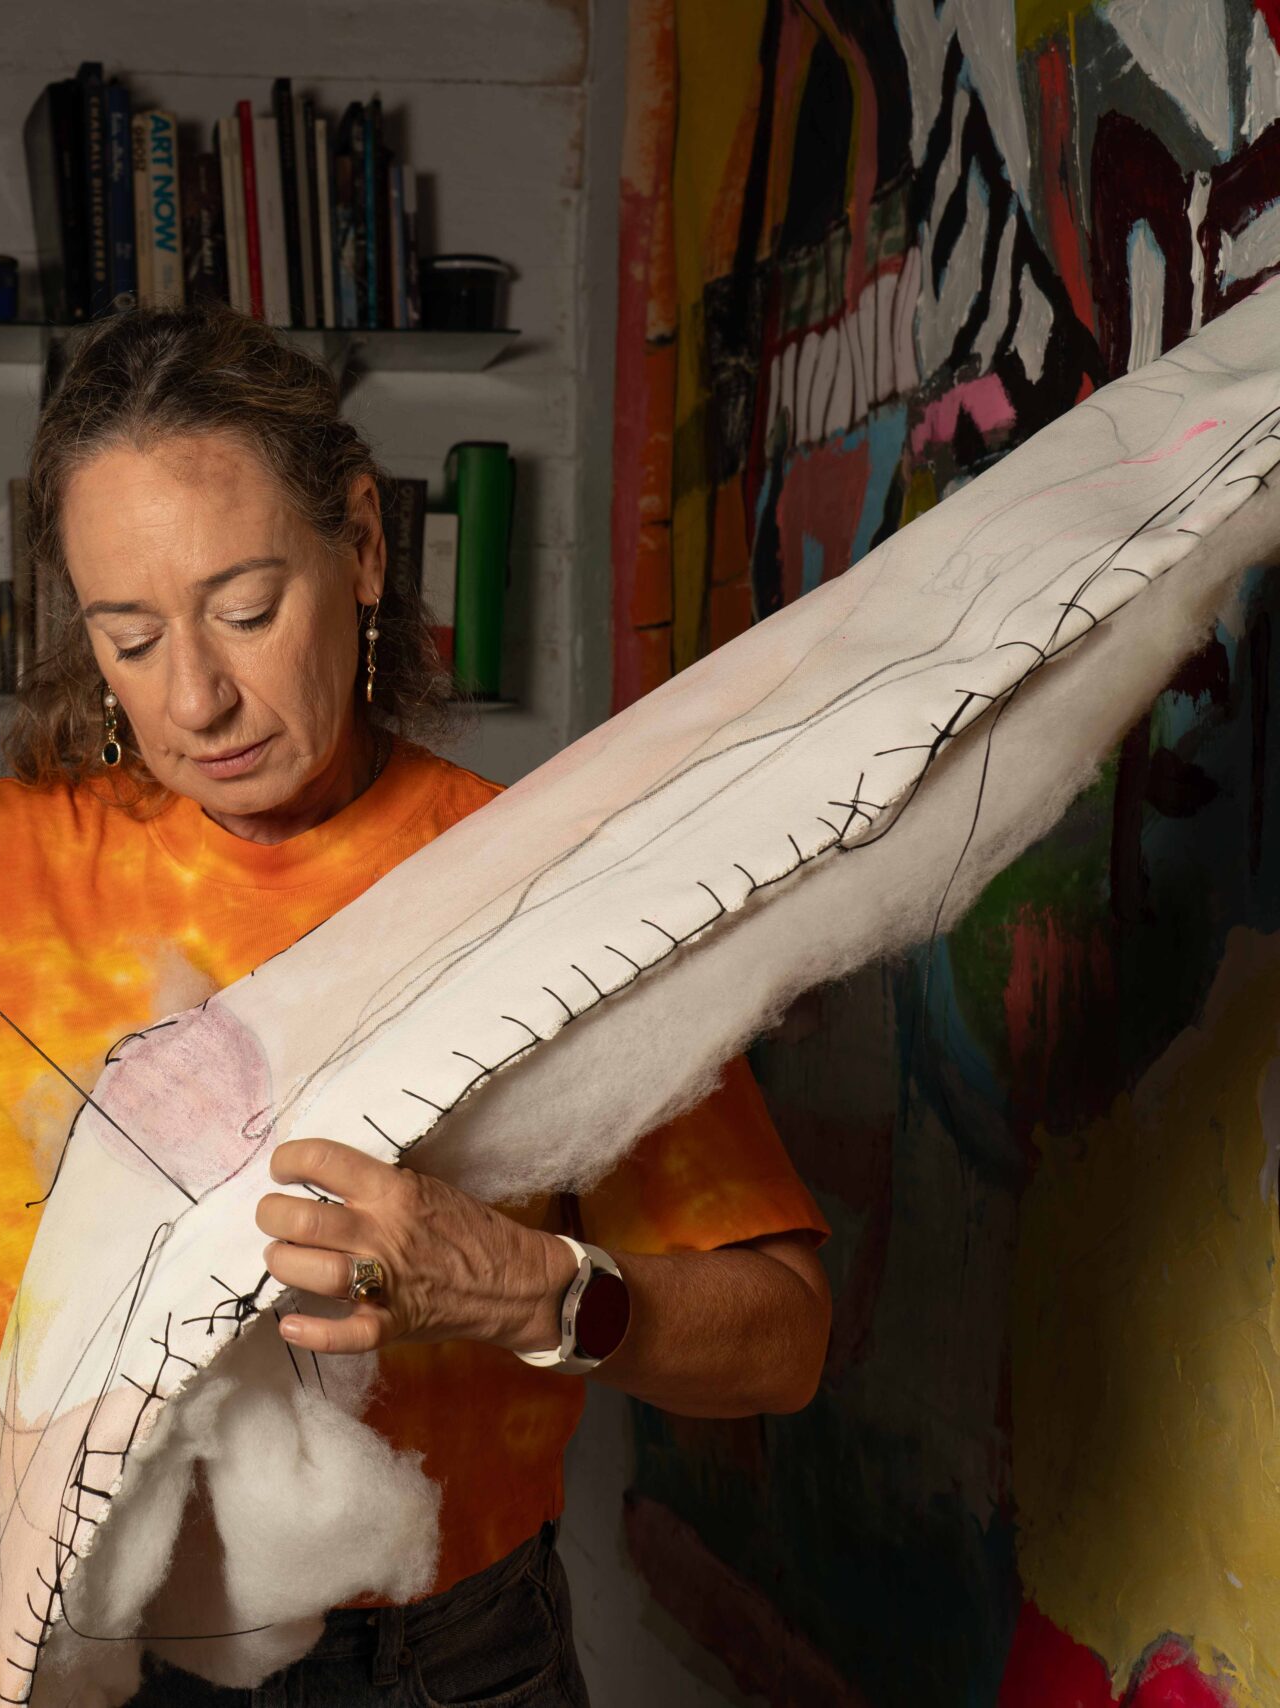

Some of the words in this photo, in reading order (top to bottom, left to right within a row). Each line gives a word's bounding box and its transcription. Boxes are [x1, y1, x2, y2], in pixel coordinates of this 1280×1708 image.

[151, 114, 173, 168] ART
[91, 177, 106, 282] DISCOVERED
[153, 175, 177, 254] NOW
